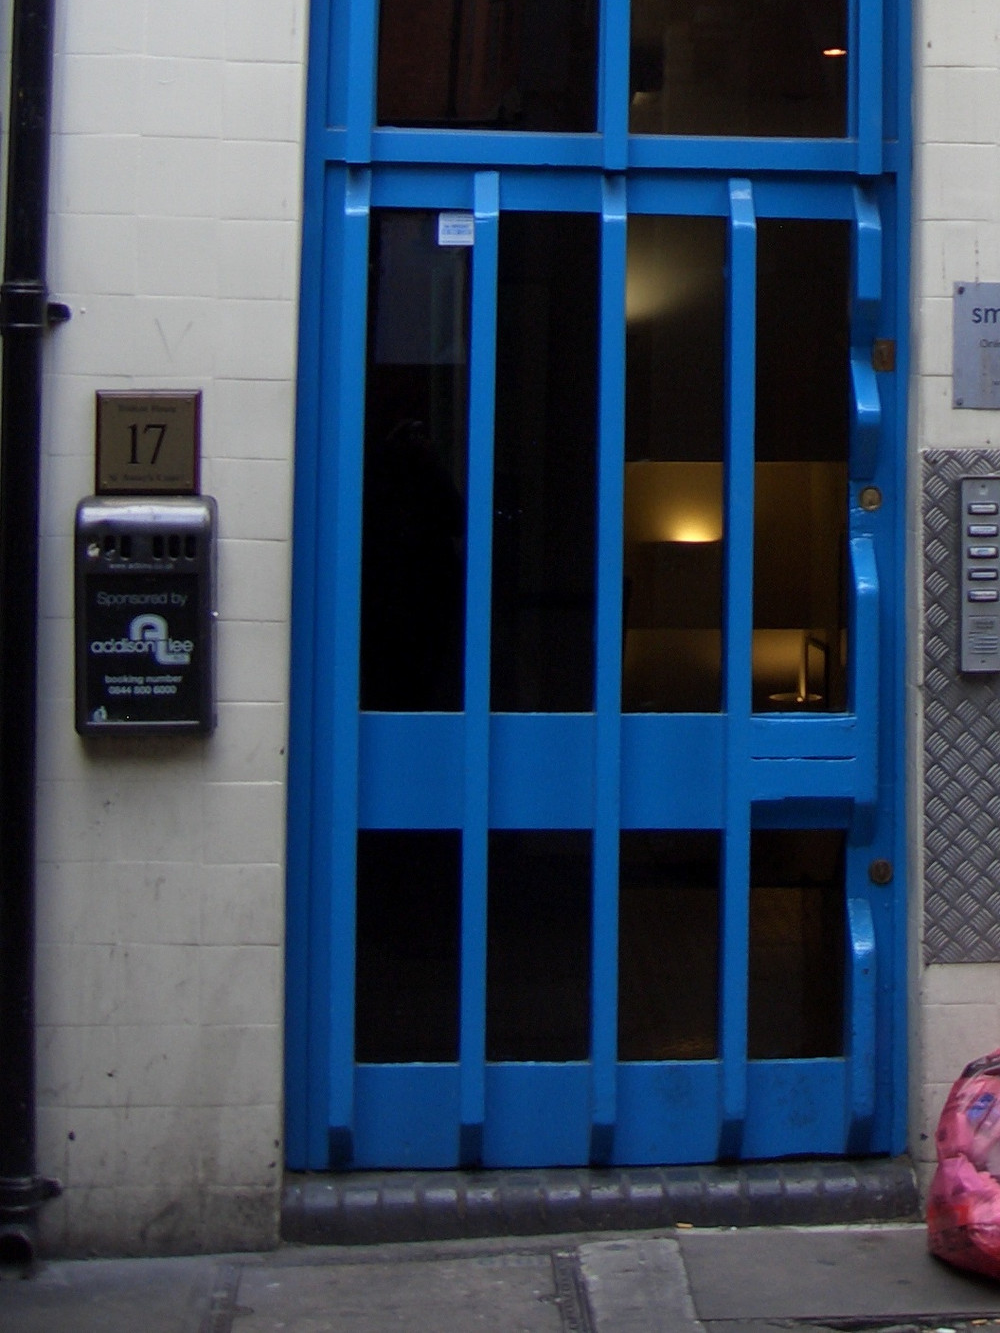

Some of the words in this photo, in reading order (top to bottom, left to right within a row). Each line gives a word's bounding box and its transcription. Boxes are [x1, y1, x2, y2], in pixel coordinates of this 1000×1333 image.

[128, 423, 168, 465] 17
[96, 591, 168, 607] Sponsored
[170, 591, 188, 607] by
[91, 637, 156, 653] addison
[168, 636, 194, 653] lee
